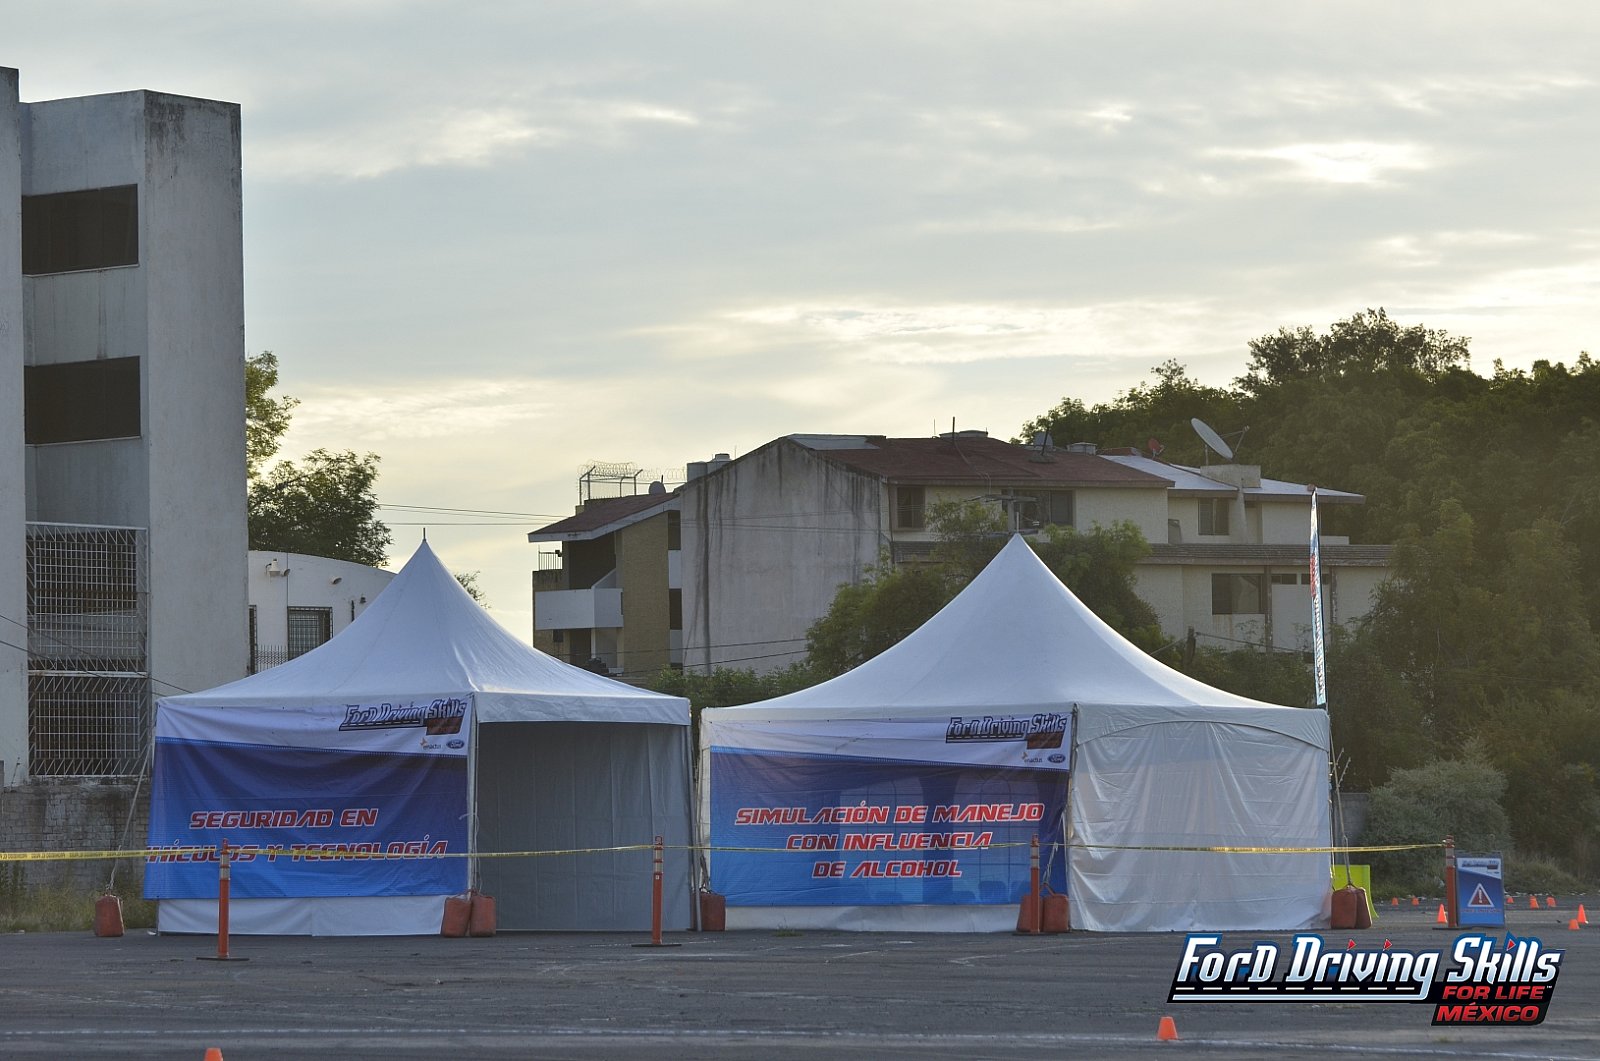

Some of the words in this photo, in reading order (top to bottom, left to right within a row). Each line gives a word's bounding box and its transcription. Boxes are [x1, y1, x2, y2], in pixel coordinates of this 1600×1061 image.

[380, 702, 428, 727] Driving
[428, 698, 467, 719] Skills
[980, 715, 1030, 740] Driving
[1030, 713, 1067, 733] Skills
[189, 809, 334, 829] SEGURIDAD
[340, 808, 378, 826] EN
[735, 800, 889, 825] SIMULACIÓN
[893, 804, 929, 824] DE
[933, 803, 1045, 822] MANEJO
[267, 845, 283, 862] Y
[291, 834, 448, 861] TECNOLOGÍA
[786, 834, 838, 850] CON
[842, 832, 993, 850] INFLUENCIA
[812, 861, 846, 878] DE
[850, 860, 963, 878] ALCOHOL
